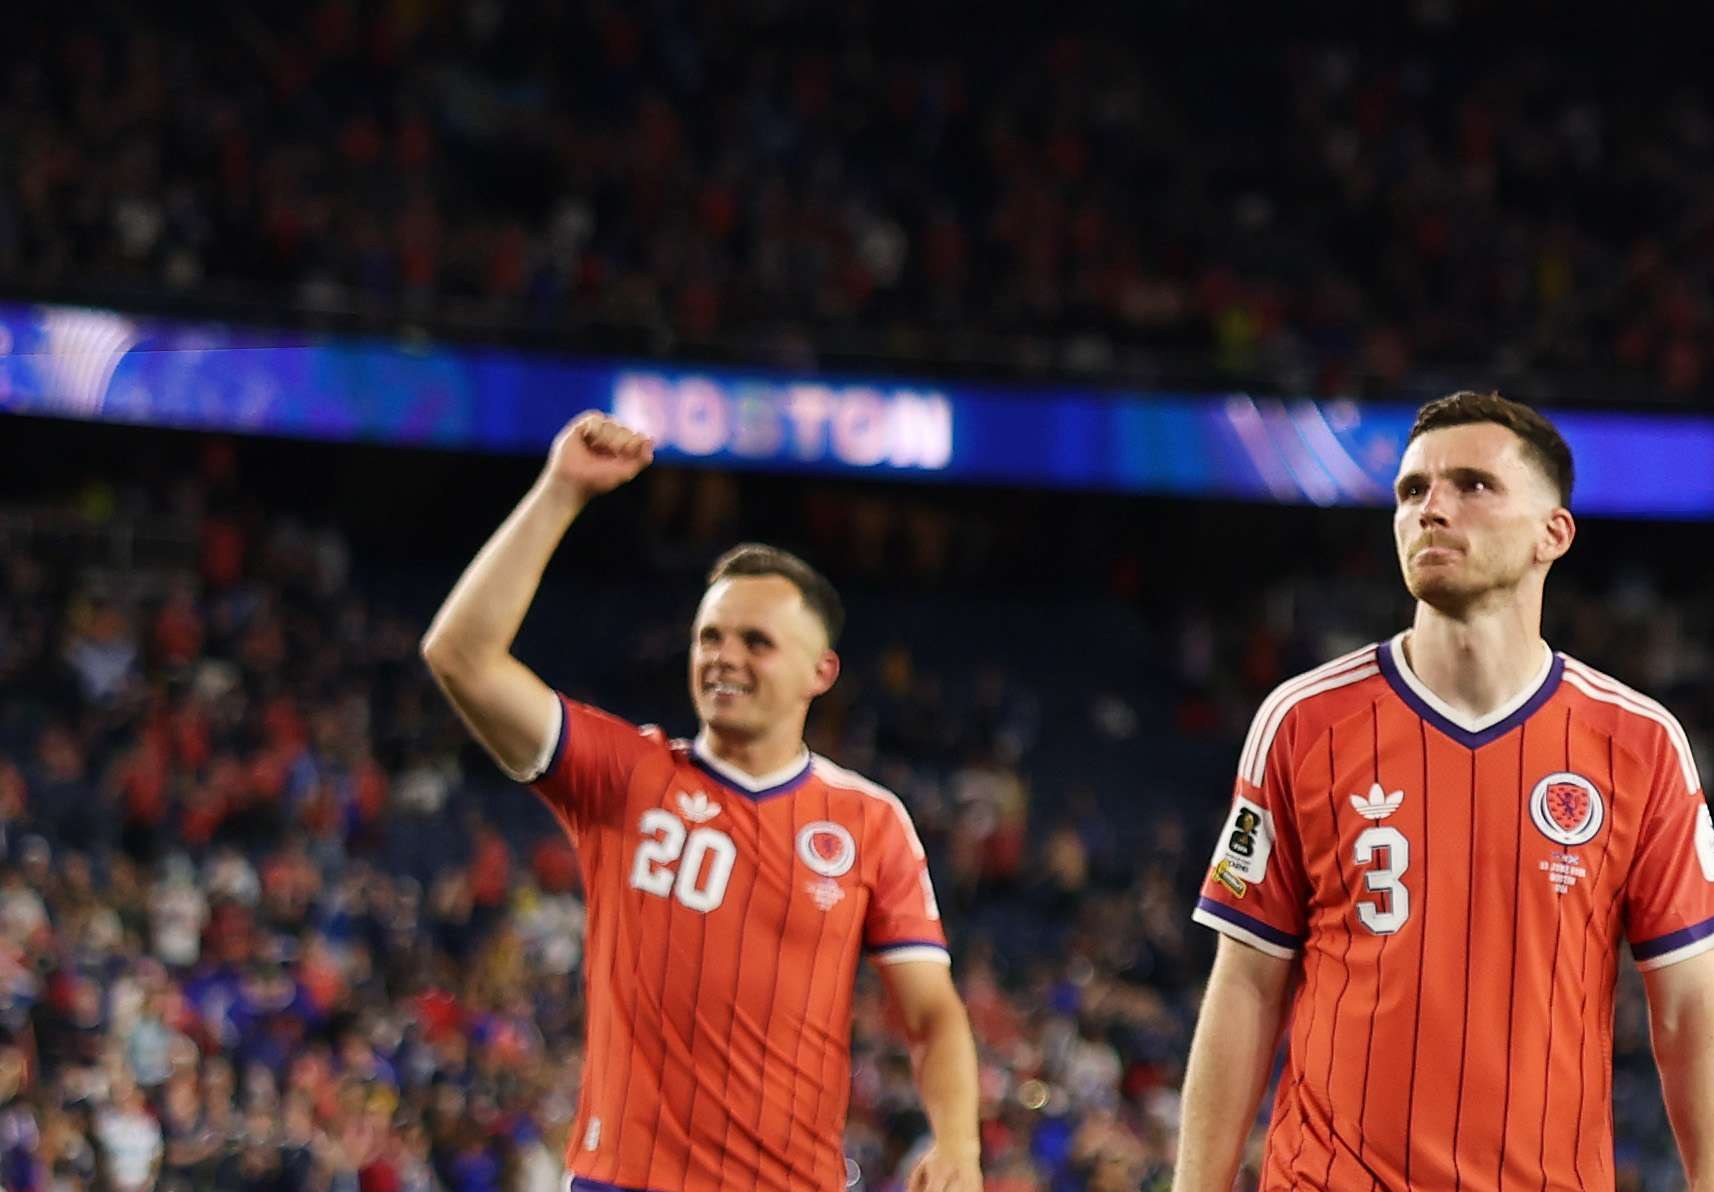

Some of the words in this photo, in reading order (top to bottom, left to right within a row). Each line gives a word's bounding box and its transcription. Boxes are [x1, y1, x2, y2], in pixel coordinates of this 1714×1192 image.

[613, 372, 951, 470] BOSTON
[630, 808, 738, 913] 20
[1355, 827, 1409, 935] 3
